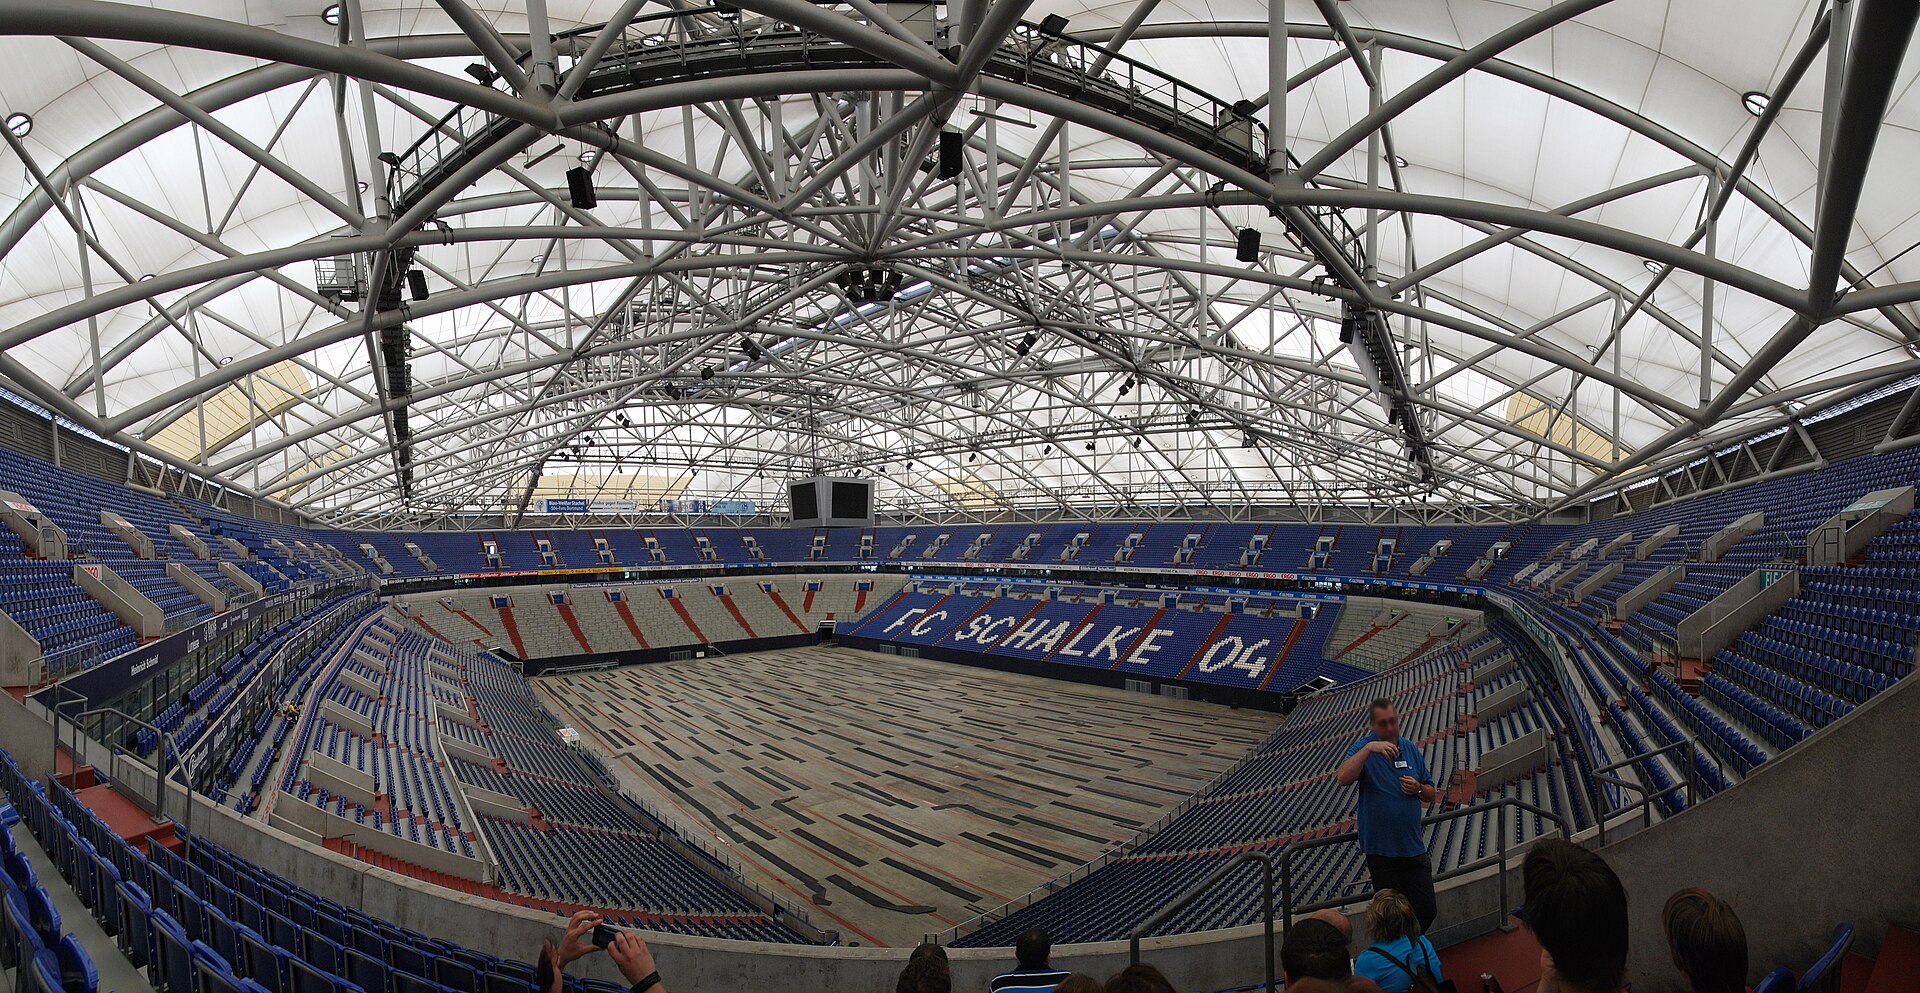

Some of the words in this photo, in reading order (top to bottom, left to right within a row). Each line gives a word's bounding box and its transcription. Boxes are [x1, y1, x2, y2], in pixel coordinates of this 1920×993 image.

[1280, 572, 1295, 580] ERGO
[883, 608, 948, 636] FC
[955, 614, 1174, 664] SCHALKE
[1199, 636, 1270, 678] 04
[130, 658, 146, 677] Heinrich
